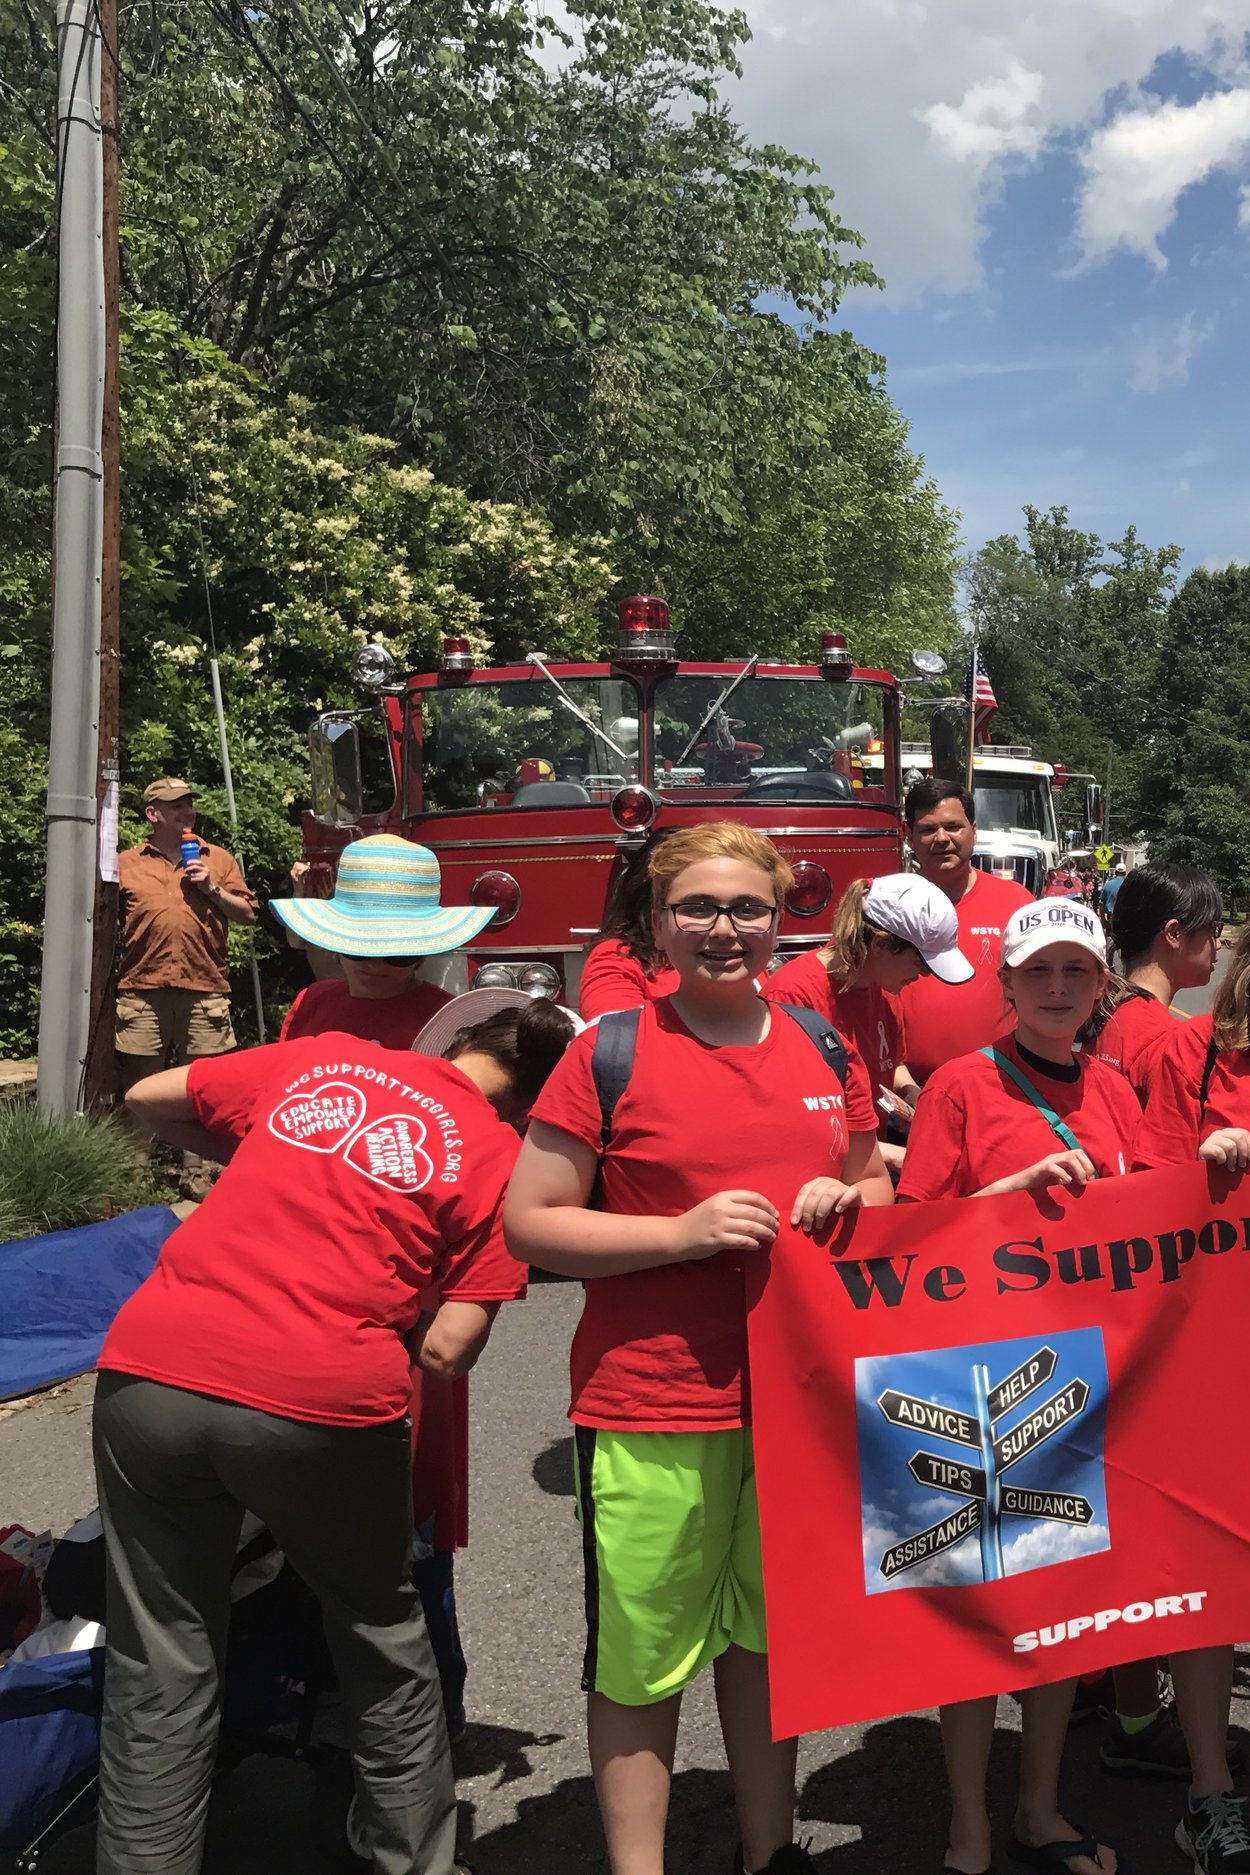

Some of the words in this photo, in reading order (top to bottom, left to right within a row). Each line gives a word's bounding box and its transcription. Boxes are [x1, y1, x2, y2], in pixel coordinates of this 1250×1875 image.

[970, 927, 1001, 936] WSTG
[1020, 913, 1042, 933] US
[1048, 909, 1094, 935] OPEN
[280, 1095, 357, 1122] EDUCATE
[284, 1107, 357, 1131] EMPOWER
[295, 1117, 351, 1140] SUPPORT
[364, 1132, 388, 1176] HEALING
[378, 1126, 403, 1179] ACTION
[394, 1120, 418, 1185] AWARENESS
[829, 1253, 967, 1310] We
[999, 1361, 1040, 1408] HELP
[898, 1399, 971, 1440] ADVICE
[1001, 1388, 1077, 1462] SUPPORT
[928, 1460, 973, 1490] TIPS
[1005, 1491, 1086, 1520] GUIDANCE
[885, 1503, 979, 1574] ASSISTANCE
[1012, 1591, 1208, 1653] SUPPORT
